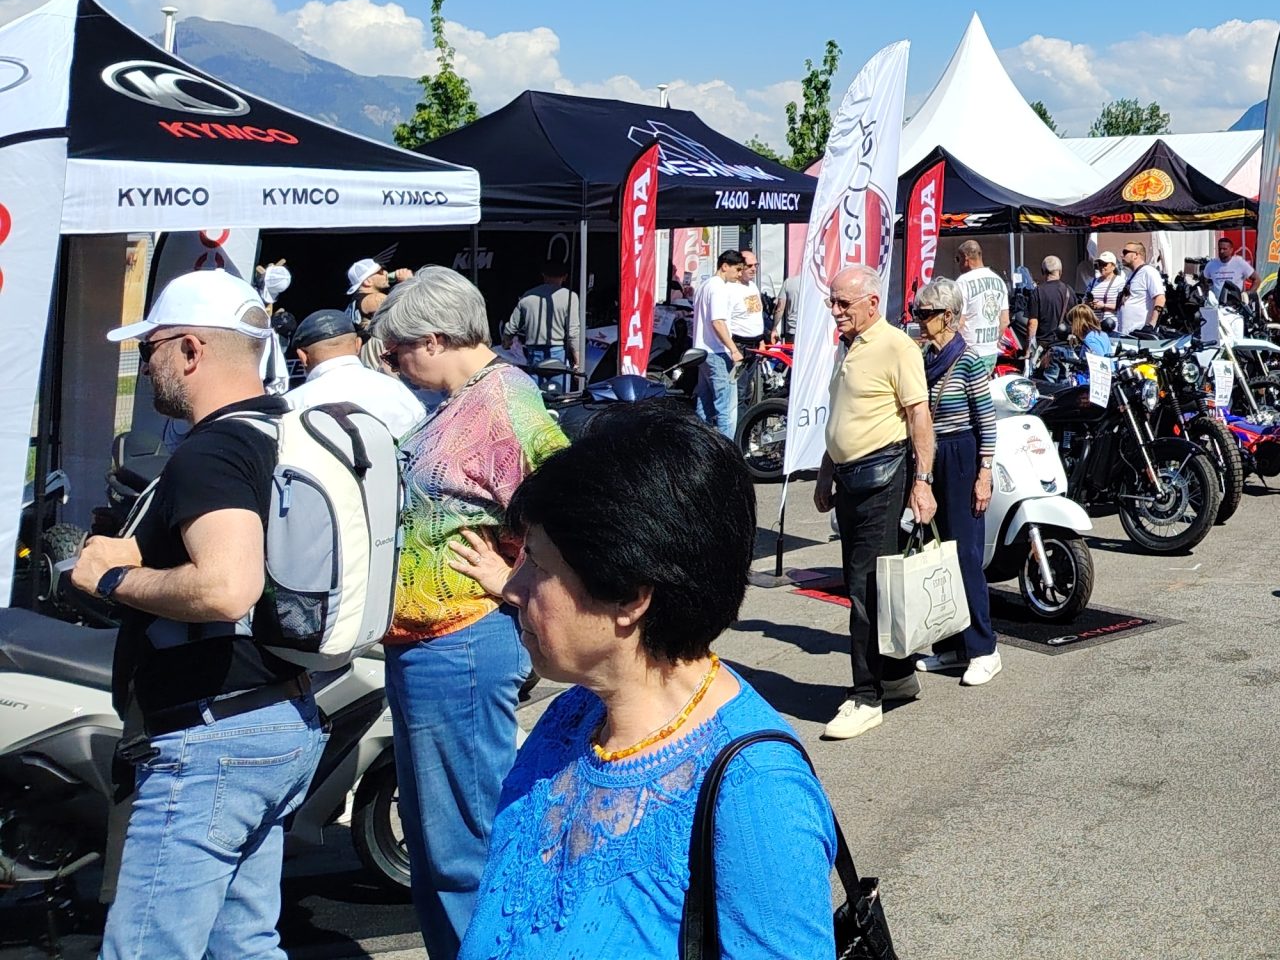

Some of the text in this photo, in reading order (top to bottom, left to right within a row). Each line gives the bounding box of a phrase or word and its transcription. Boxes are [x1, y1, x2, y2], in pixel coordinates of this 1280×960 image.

[158, 120, 299, 145] KYMCO
[117, 187, 210, 207] KYMCO
[262, 187, 340, 206] KYMCO
[381, 189, 449, 206] KYMCO
[714, 190, 750, 209] 74600
[757, 191, 801, 211] ANNECY
[920, 179, 936, 285] ONDA
